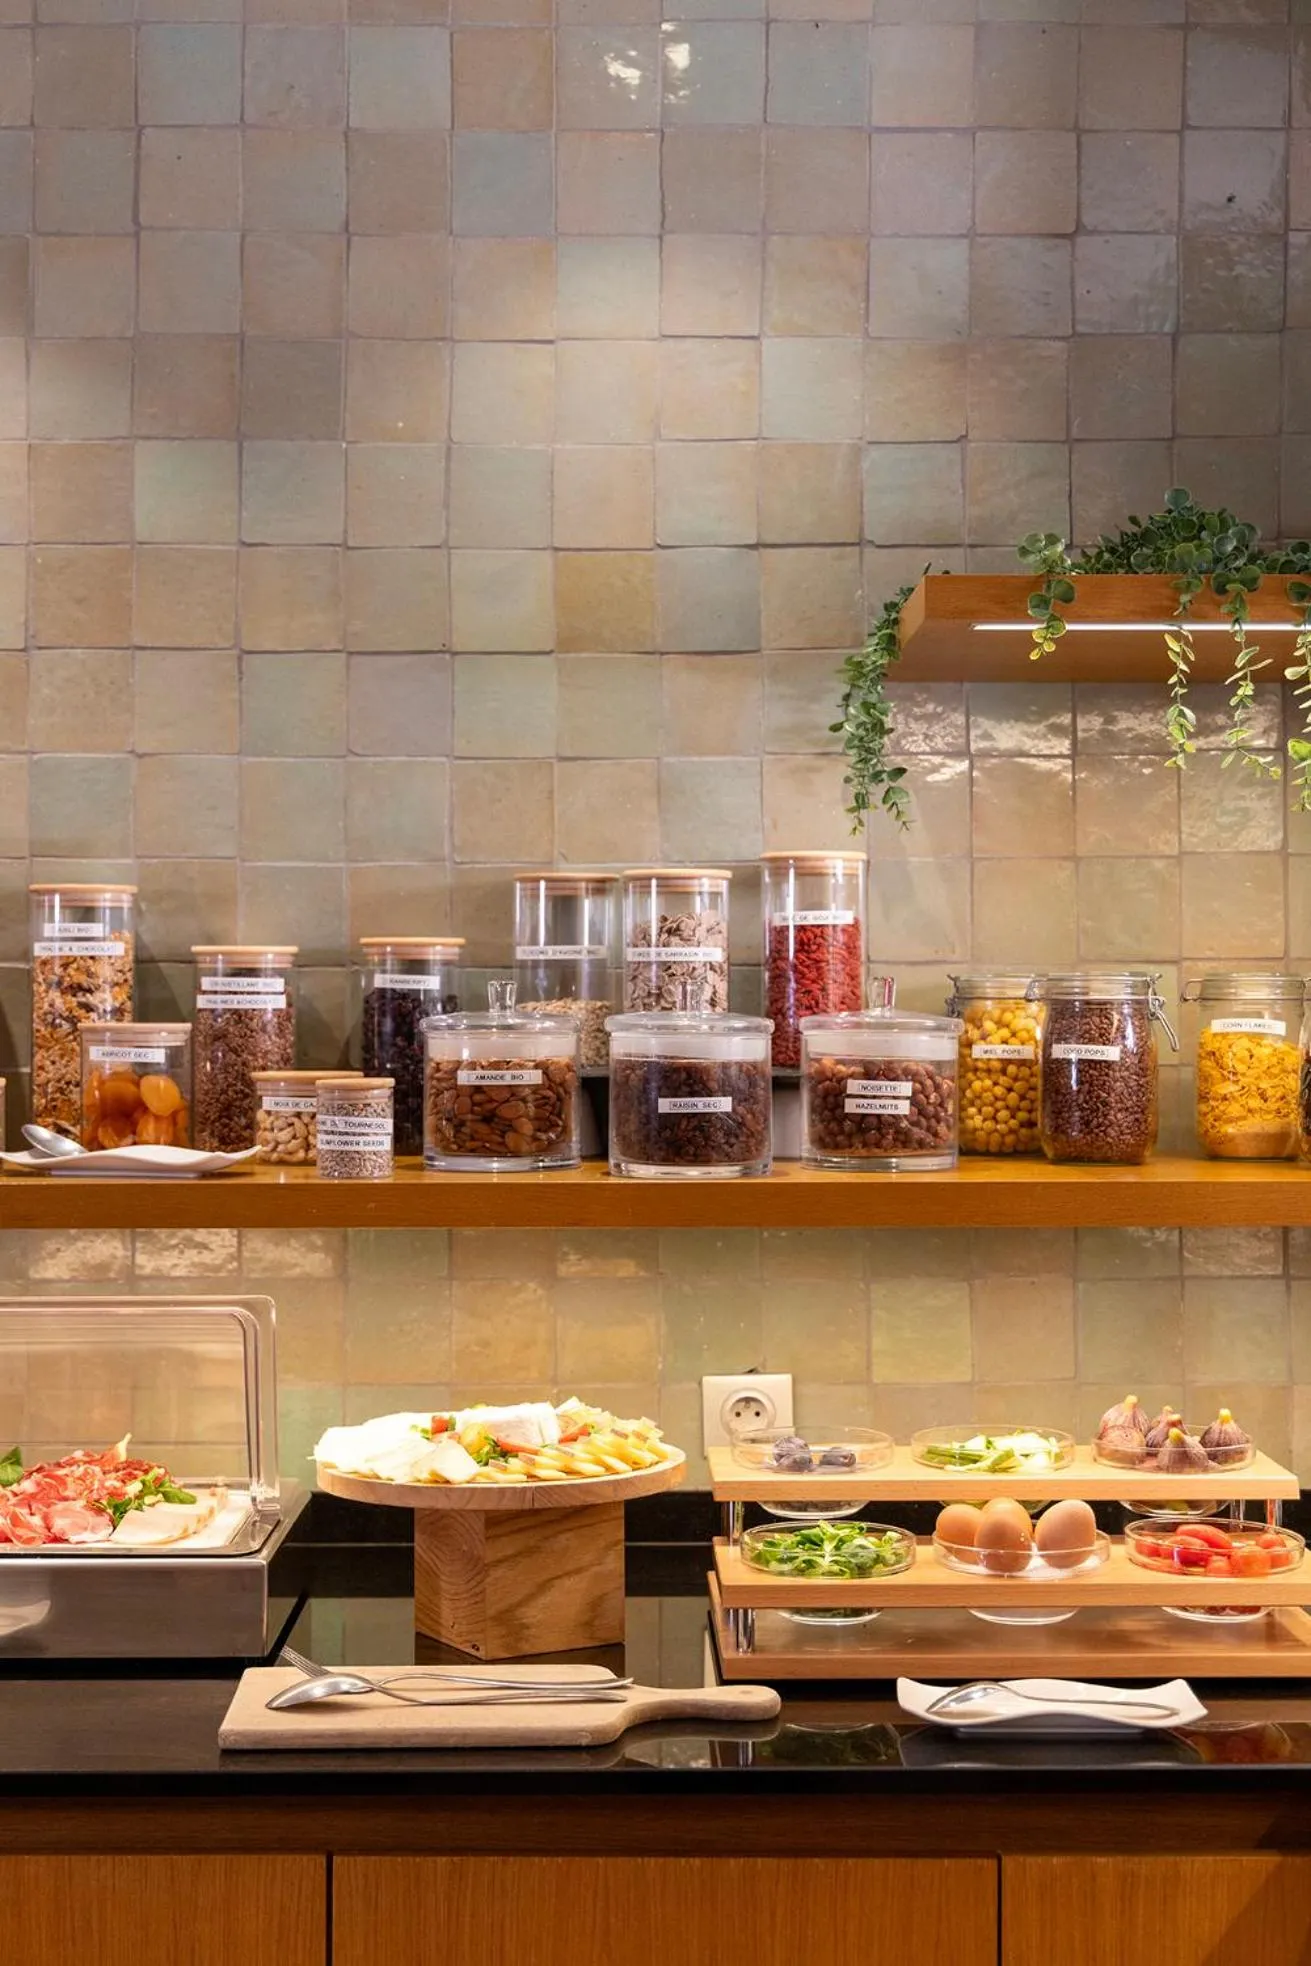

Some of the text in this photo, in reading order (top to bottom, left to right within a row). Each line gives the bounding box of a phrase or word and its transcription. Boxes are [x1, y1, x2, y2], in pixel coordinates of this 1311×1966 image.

[101, 1050, 150, 1059] ABRICOT SEC
[1084, 1048, 1106, 1057] POPS
[474, 1073, 524, 1081] AMANDE BIO
[860, 1083, 898, 1092] NOISETTE
[273, 1100, 289, 1108] NOIX
[672, 1101, 718, 1109] RAISIN SEC
[855, 1102, 899, 1110] HAZELNUTS
[343, 1120, 386, 1130] TOURNESOL
[319, 1139, 385, 1147] UNFLOWER SEEDS
